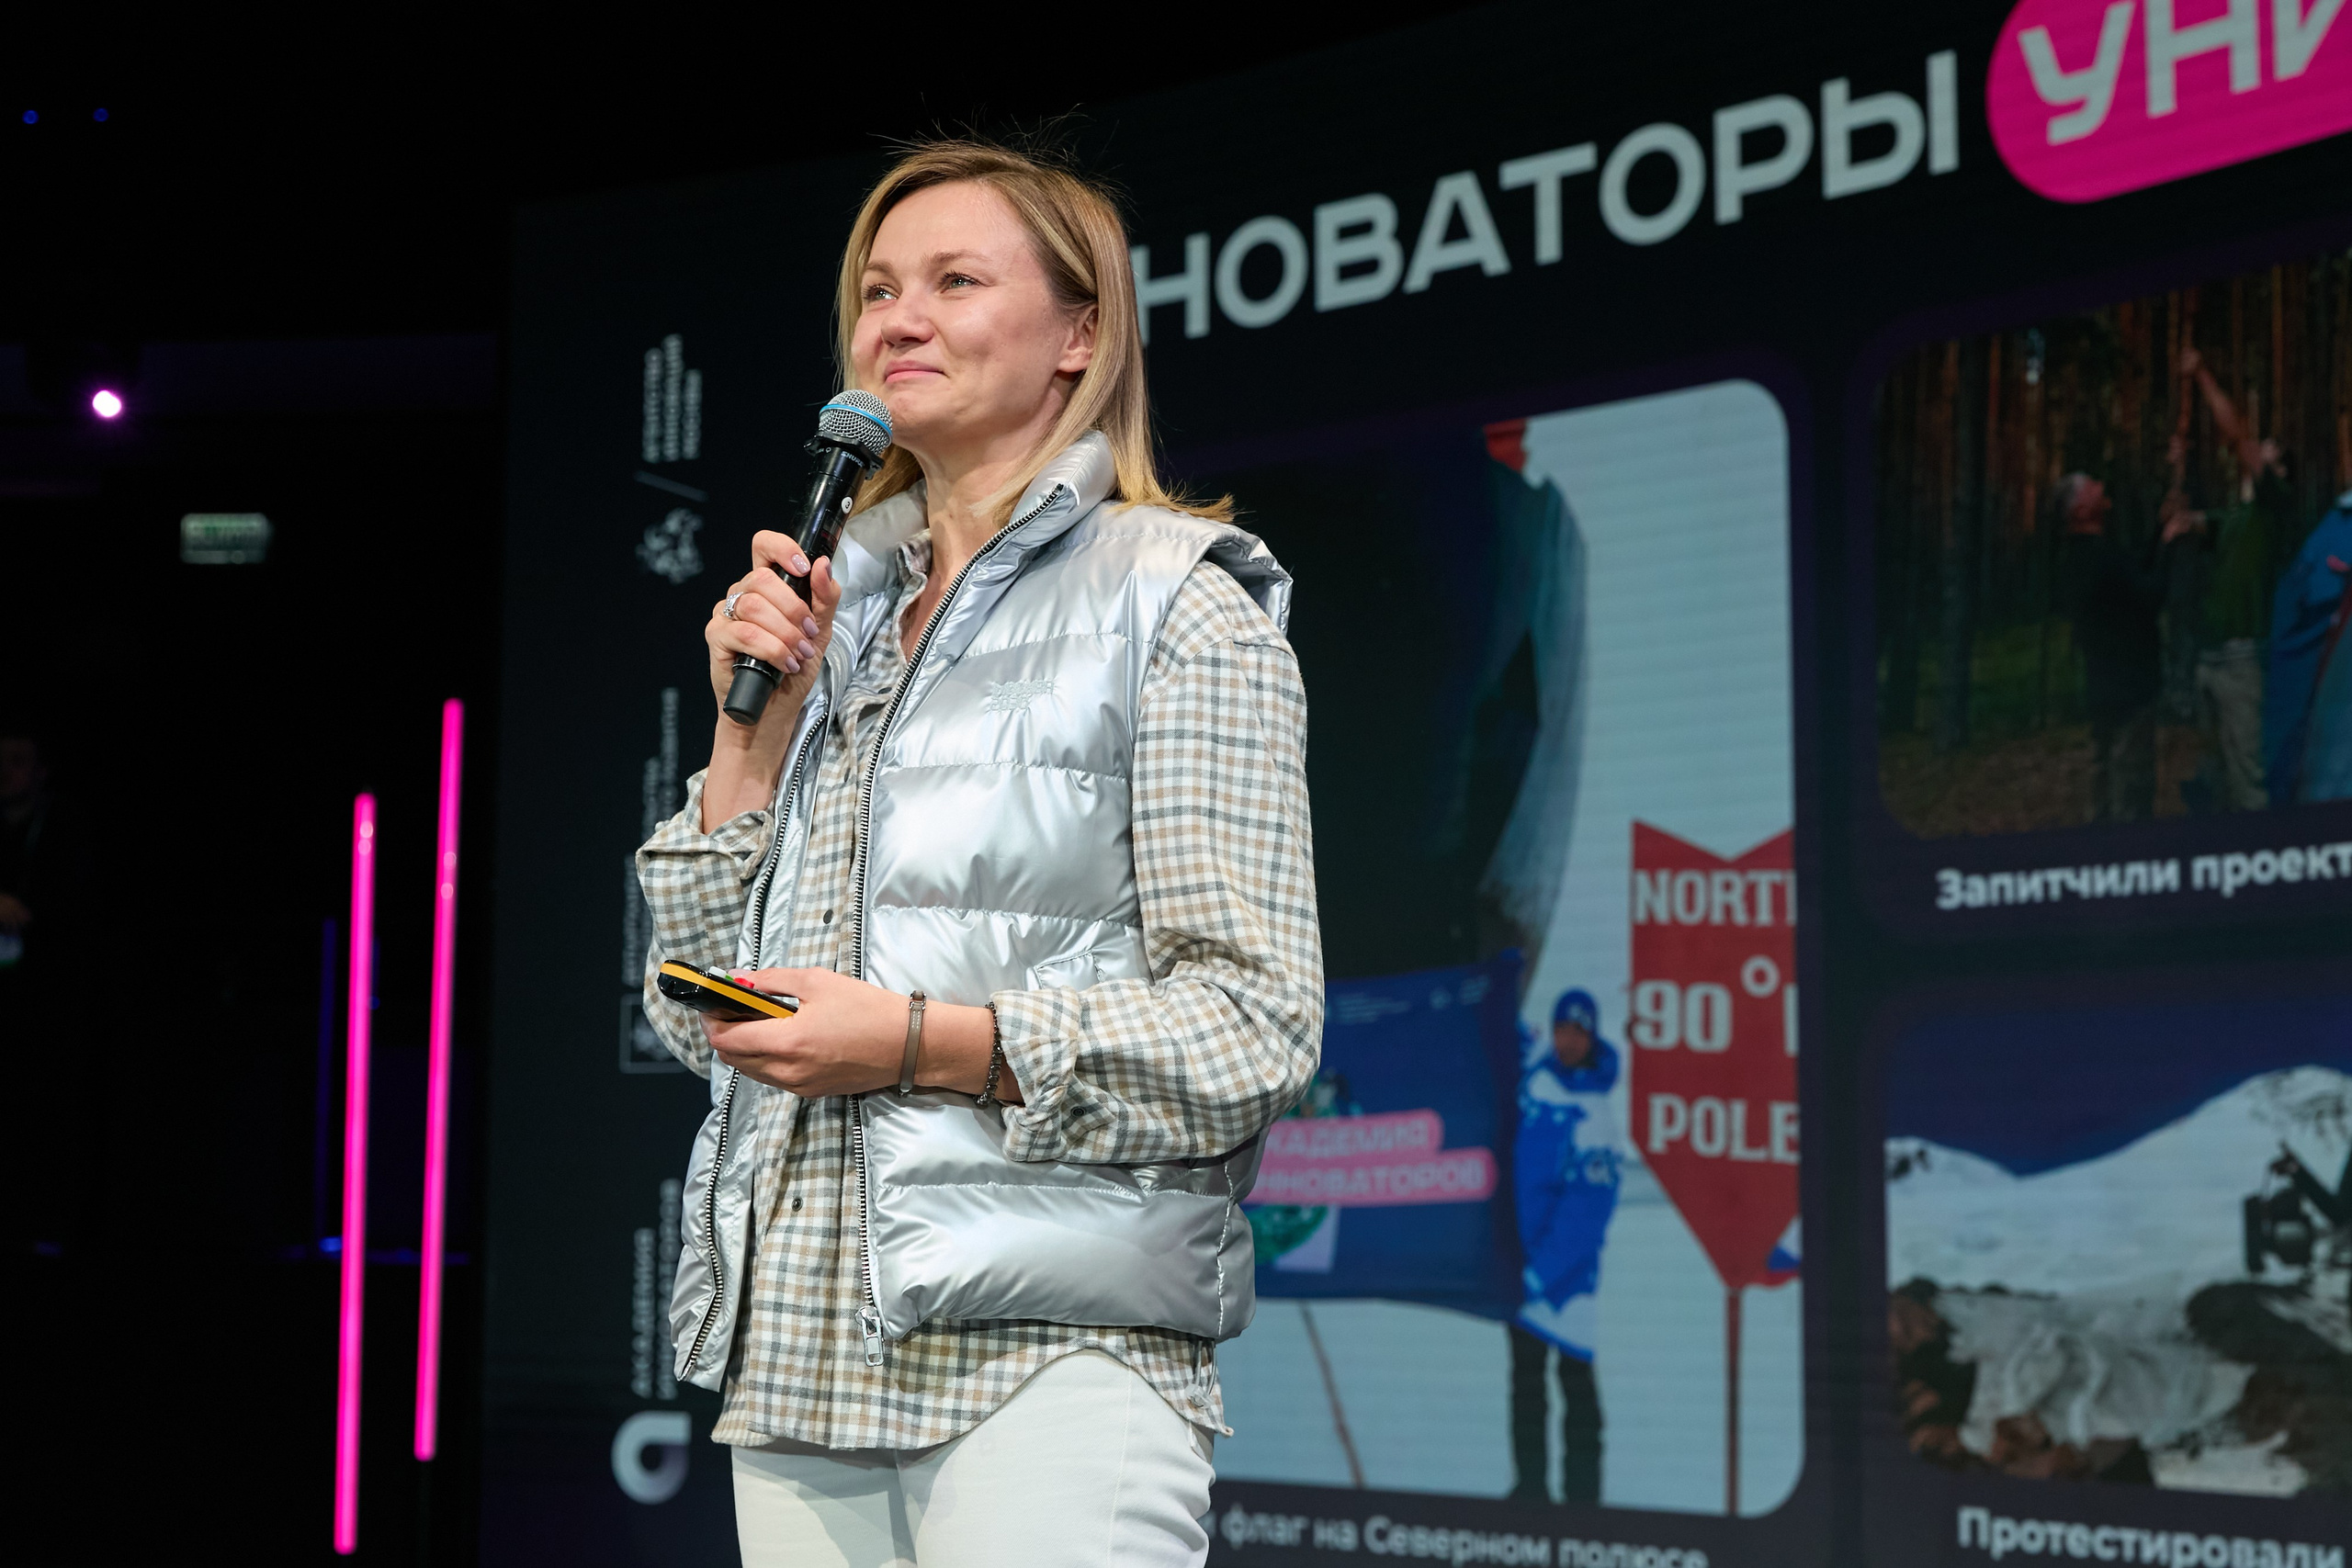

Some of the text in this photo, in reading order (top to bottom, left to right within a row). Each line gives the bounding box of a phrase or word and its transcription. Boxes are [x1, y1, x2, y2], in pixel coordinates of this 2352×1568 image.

[1935, 840, 2352, 910] Запитчили проект
[1647, 1092, 1801, 1165] POLE
[1220, 1503, 1309, 1551] флаг
[1313, 1517, 1360, 1552] на
[1363, 1514, 1551, 1566] Северном
[1559, 1537, 1711, 1568] полюсе
[1956, 1505, 2345, 1568] Протестировали
